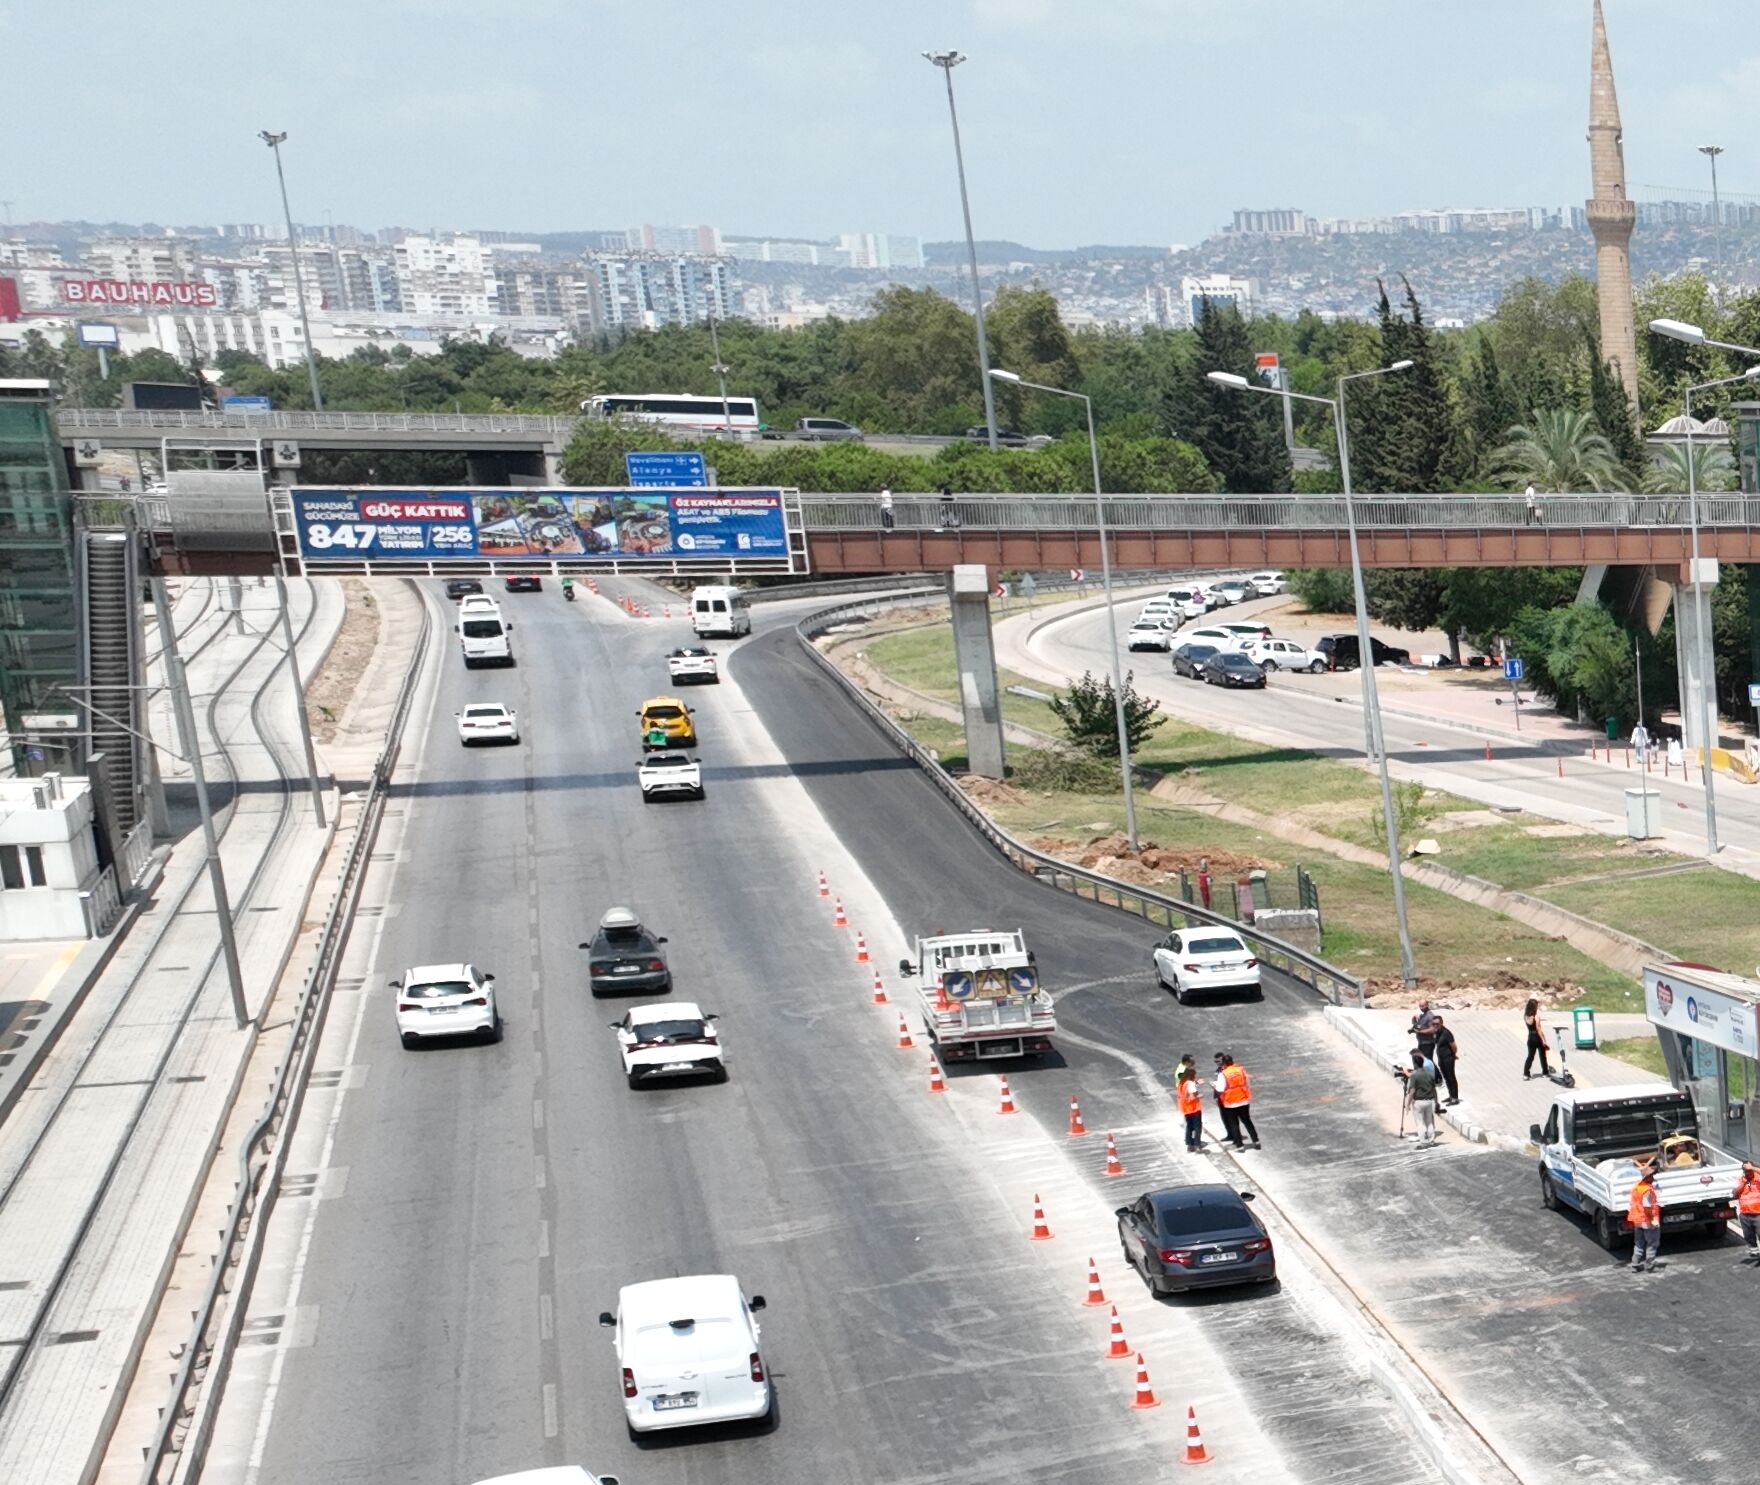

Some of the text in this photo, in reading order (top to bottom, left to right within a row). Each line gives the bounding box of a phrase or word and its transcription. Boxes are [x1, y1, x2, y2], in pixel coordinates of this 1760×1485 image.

[66, 283, 214, 303] BAUHAUS
[365, 502, 466, 519] GÜÇ KATTIK
[308, 524, 376, 549] 847
[432, 526, 473, 542] 256
